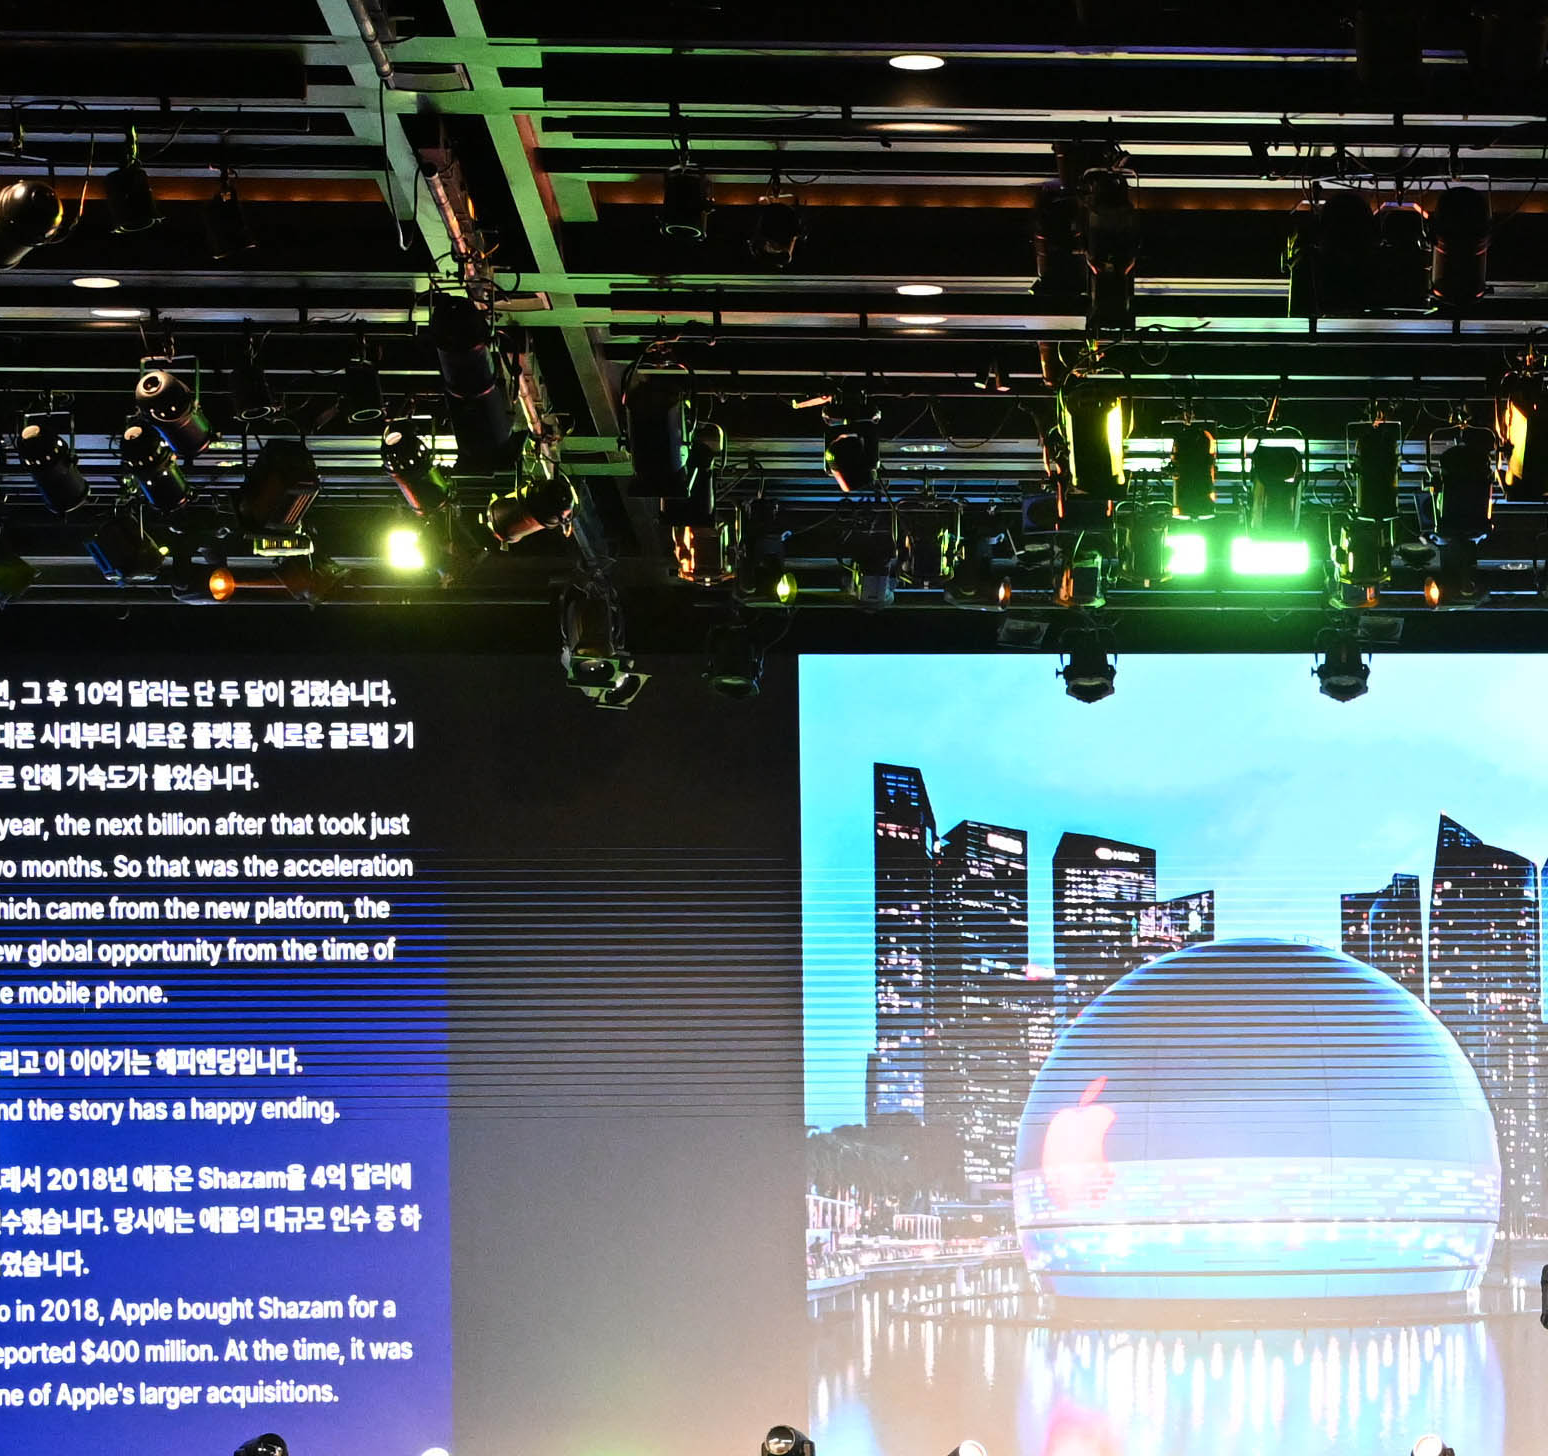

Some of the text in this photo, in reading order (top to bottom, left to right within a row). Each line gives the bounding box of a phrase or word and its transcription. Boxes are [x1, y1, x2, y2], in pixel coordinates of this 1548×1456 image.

[21, 682, 42, 704] 그
[47, 680, 68, 707] 후
[75, 680, 122, 706] 10억
[129, 680, 189, 707] 달러는
[194, 680, 215, 706] 단
[219, 681, 240, 707] 두
[245, 680, 284, 707] 달이
[291, 680, 396, 707] 걸렸습니다.
[41, 722, 120, 749] 시대부터
[126, 722, 187, 748] 새로운
[264, 722, 324, 748] 새로운
[329, 722, 388, 748] 글로벌
[394, 722, 413, 748] 기
[21, 764, 61, 790] 인해
[67, 764, 148, 791] 가속도가
[55, 814, 90, 835] the
[96, 815, 142, 835] next
[148, 813, 210, 835] billion
[215, 812, 266, 835] after
[271, 813, 313, 835] that
[319, 813, 366, 834] took
[370, 812, 409, 840] just
[22, 856, 107, 877] months.
[114, 855, 141, 877] So
[147, 855, 190, 877] that
[195, 860, 238, 876] was
[243, 855, 278, 877] the
[284, 854, 413, 876] acceleration
[46, 902, 104, 919] came
[109, 896, 159, 919] from
[164, 897, 199, 919] the
[205, 902, 250, 919] new
[256, 896, 349, 924] platform,
[355, 896, 390, 918] the
[28, 939, 92, 967] global
[98, 938, 222, 966] opportunity
[227, 938, 276, 961] from
[282, 938, 317, 961] the
[322, 937, 368, 960] time
[374, 936, 396, 960] of
[19, 981, 90, 1003] mobile
[96, 981, 167, 1008] phone.
[45, 1049, 64, 1076] 이
[71, 1049, 151, 1076] 이야기는
[156, 1047, 302, 1075] 해피엔딩입니다.
[28, 1099, 63, 1120] the
[69, 1100, 124, 1125] story
[130, 1098, 167, 1120] has
[173, 1102, 185, 1119] a
[191, 1098, 256, 1124] happy
[262, 1096, 340, 1124] ending.
[48, 1165, 127, 1192] 2018년
[133, 1165, 193, 1192] 애플은
[199, 1164, 306, 1191] Shazam을
[311, 1163, 346, 1190] 4억
[352, 1163, 411, 1190] 달러에
[114, 1207, 195, 1234] 당시에는
[199, 1206, 259, 1233] 애플의
[265, 1206, 325, 1232] 대규모
[330, 1205, 371, 1232] 인수
[375, 1205, 396, 1232] 중
[400, 1204, 422, 1231] 하
[16, 1300, 34, 1321] in
[42, 1299, 104, 1326] 2018,
[111, 1298, 172, 1325] Apple
[178, 1297, 253, 1325] bought
[259, 1297, 343, 1319] Shazam
[348, 1295, 378, 1318] for
[383, 1300, 396, 1318] a
[82, 1339, 139, 1364] $400
[146, 1340, 218, 1362] million.
[224, 1339, 248, 1361] At
[253, 1339, 288, 1361] the
[293, 1338, 344, 1365] time,
[351, 1337, 365, 1359] it
[370, 1342, 412, 1359] was
[29, 1383, 51, 1405] of
[57, 1383, 134, 1410] Apple's
[140, 1383, 201, 1409] larger
[207, 1380, 338, 1408] acquisitions.
